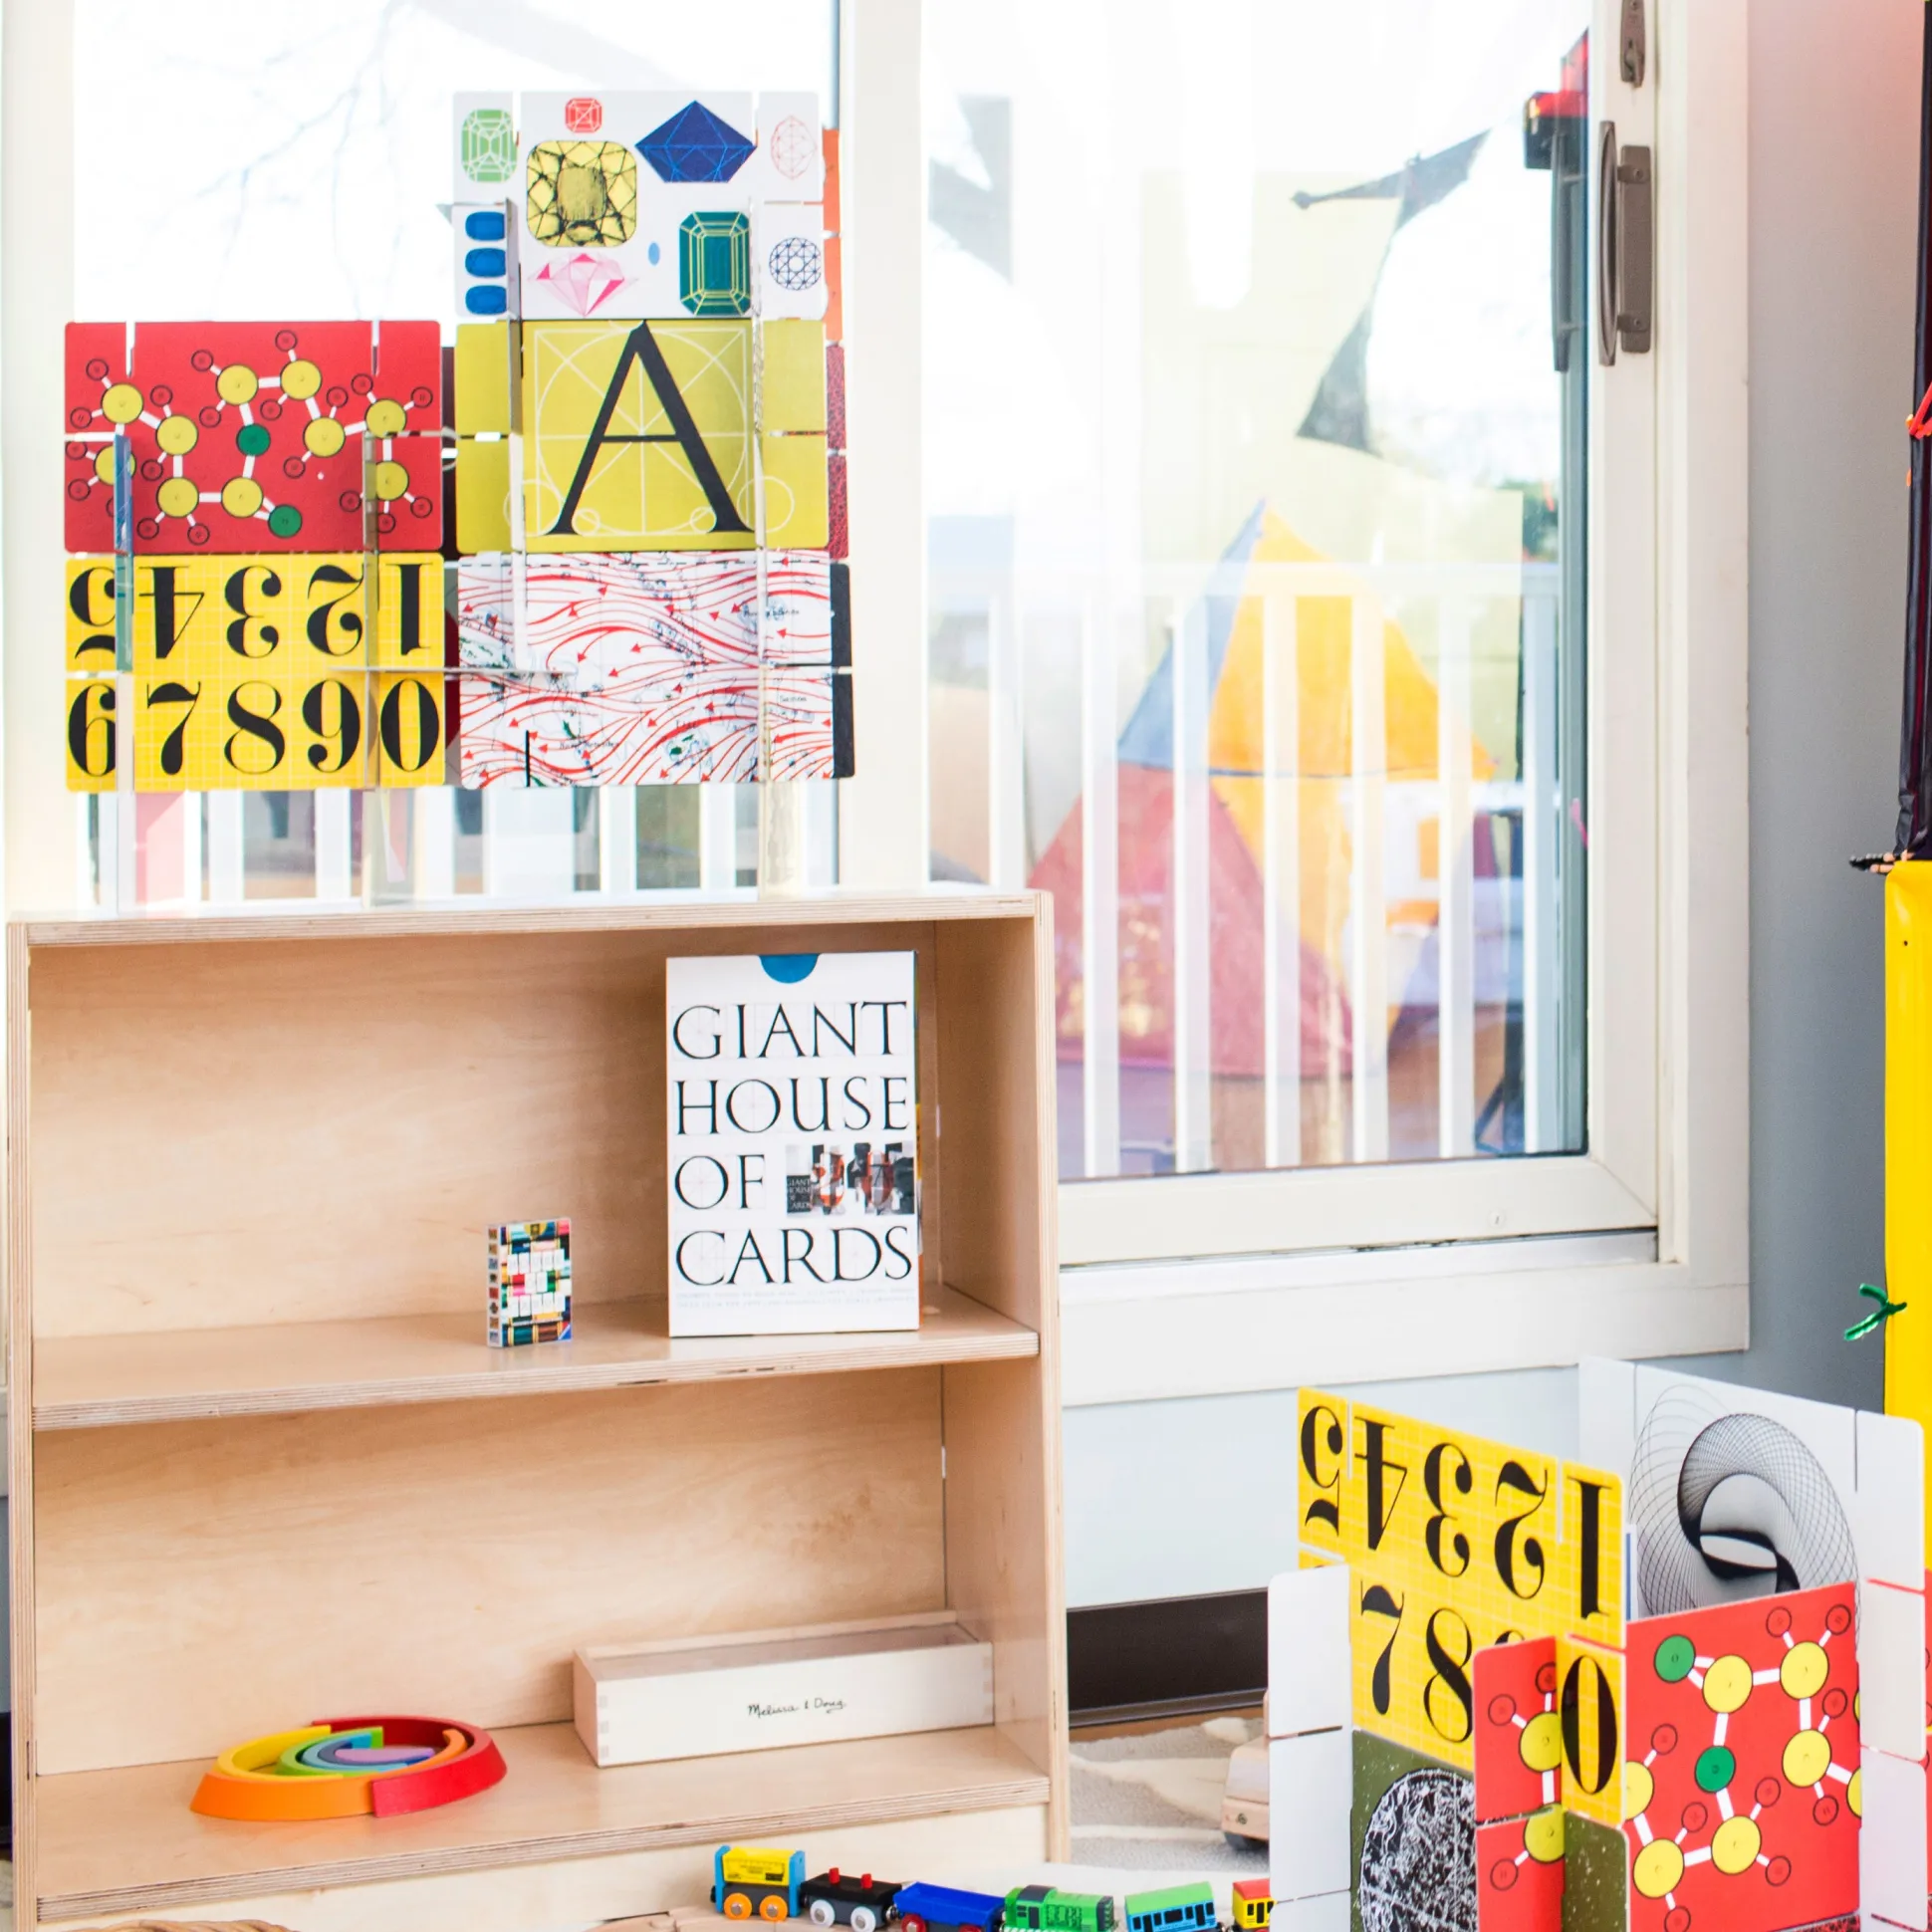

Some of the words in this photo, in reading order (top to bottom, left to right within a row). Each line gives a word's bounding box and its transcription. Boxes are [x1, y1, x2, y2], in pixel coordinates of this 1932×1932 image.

[544, 319, 755, 535] A
[672, 1001, 908, 1060] GIANT
[675, 1077, 909, 1135] HOUSE
[674, 1154, 765, 1210] OF
[675, 1225, 913, 1286] CARDS
[814, 1697, 847, 1714] Doug
